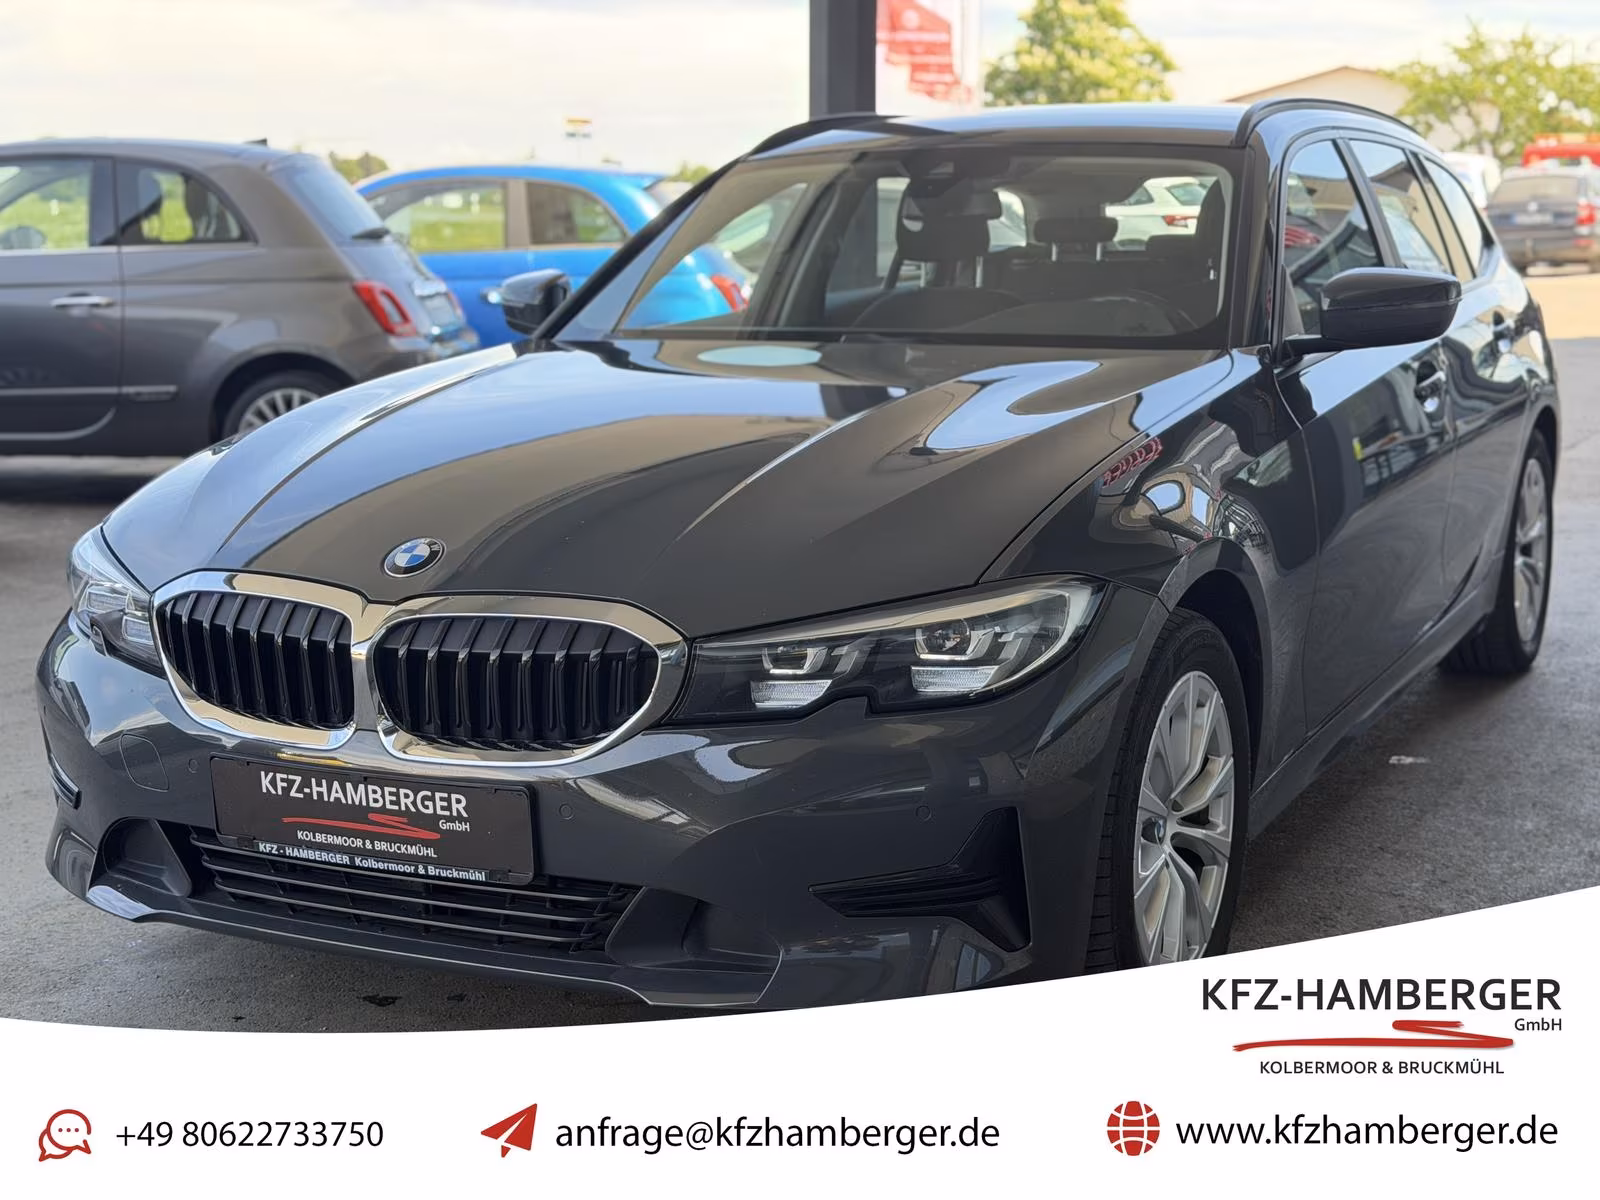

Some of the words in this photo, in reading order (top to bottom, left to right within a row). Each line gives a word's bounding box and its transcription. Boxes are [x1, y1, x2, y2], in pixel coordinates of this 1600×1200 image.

[260, 771, 469, 818] KFZ-HAMBERGER
[439, 819, 470, 832] GmbH
[296, 830, 364, 849] KOLBERMOOR
[365, 839, 373, 850] &
[374, 841, 438, 858] BRUCKMÜHL
[258, 842, 279, 855] KFZ
[285, 846, 351, 865] HAMBERGER
[354, 857, 416, 873] Kolbermoor
[417, 865, 426, 875] &
[427, 866, 487, 882] Bruckmühl
